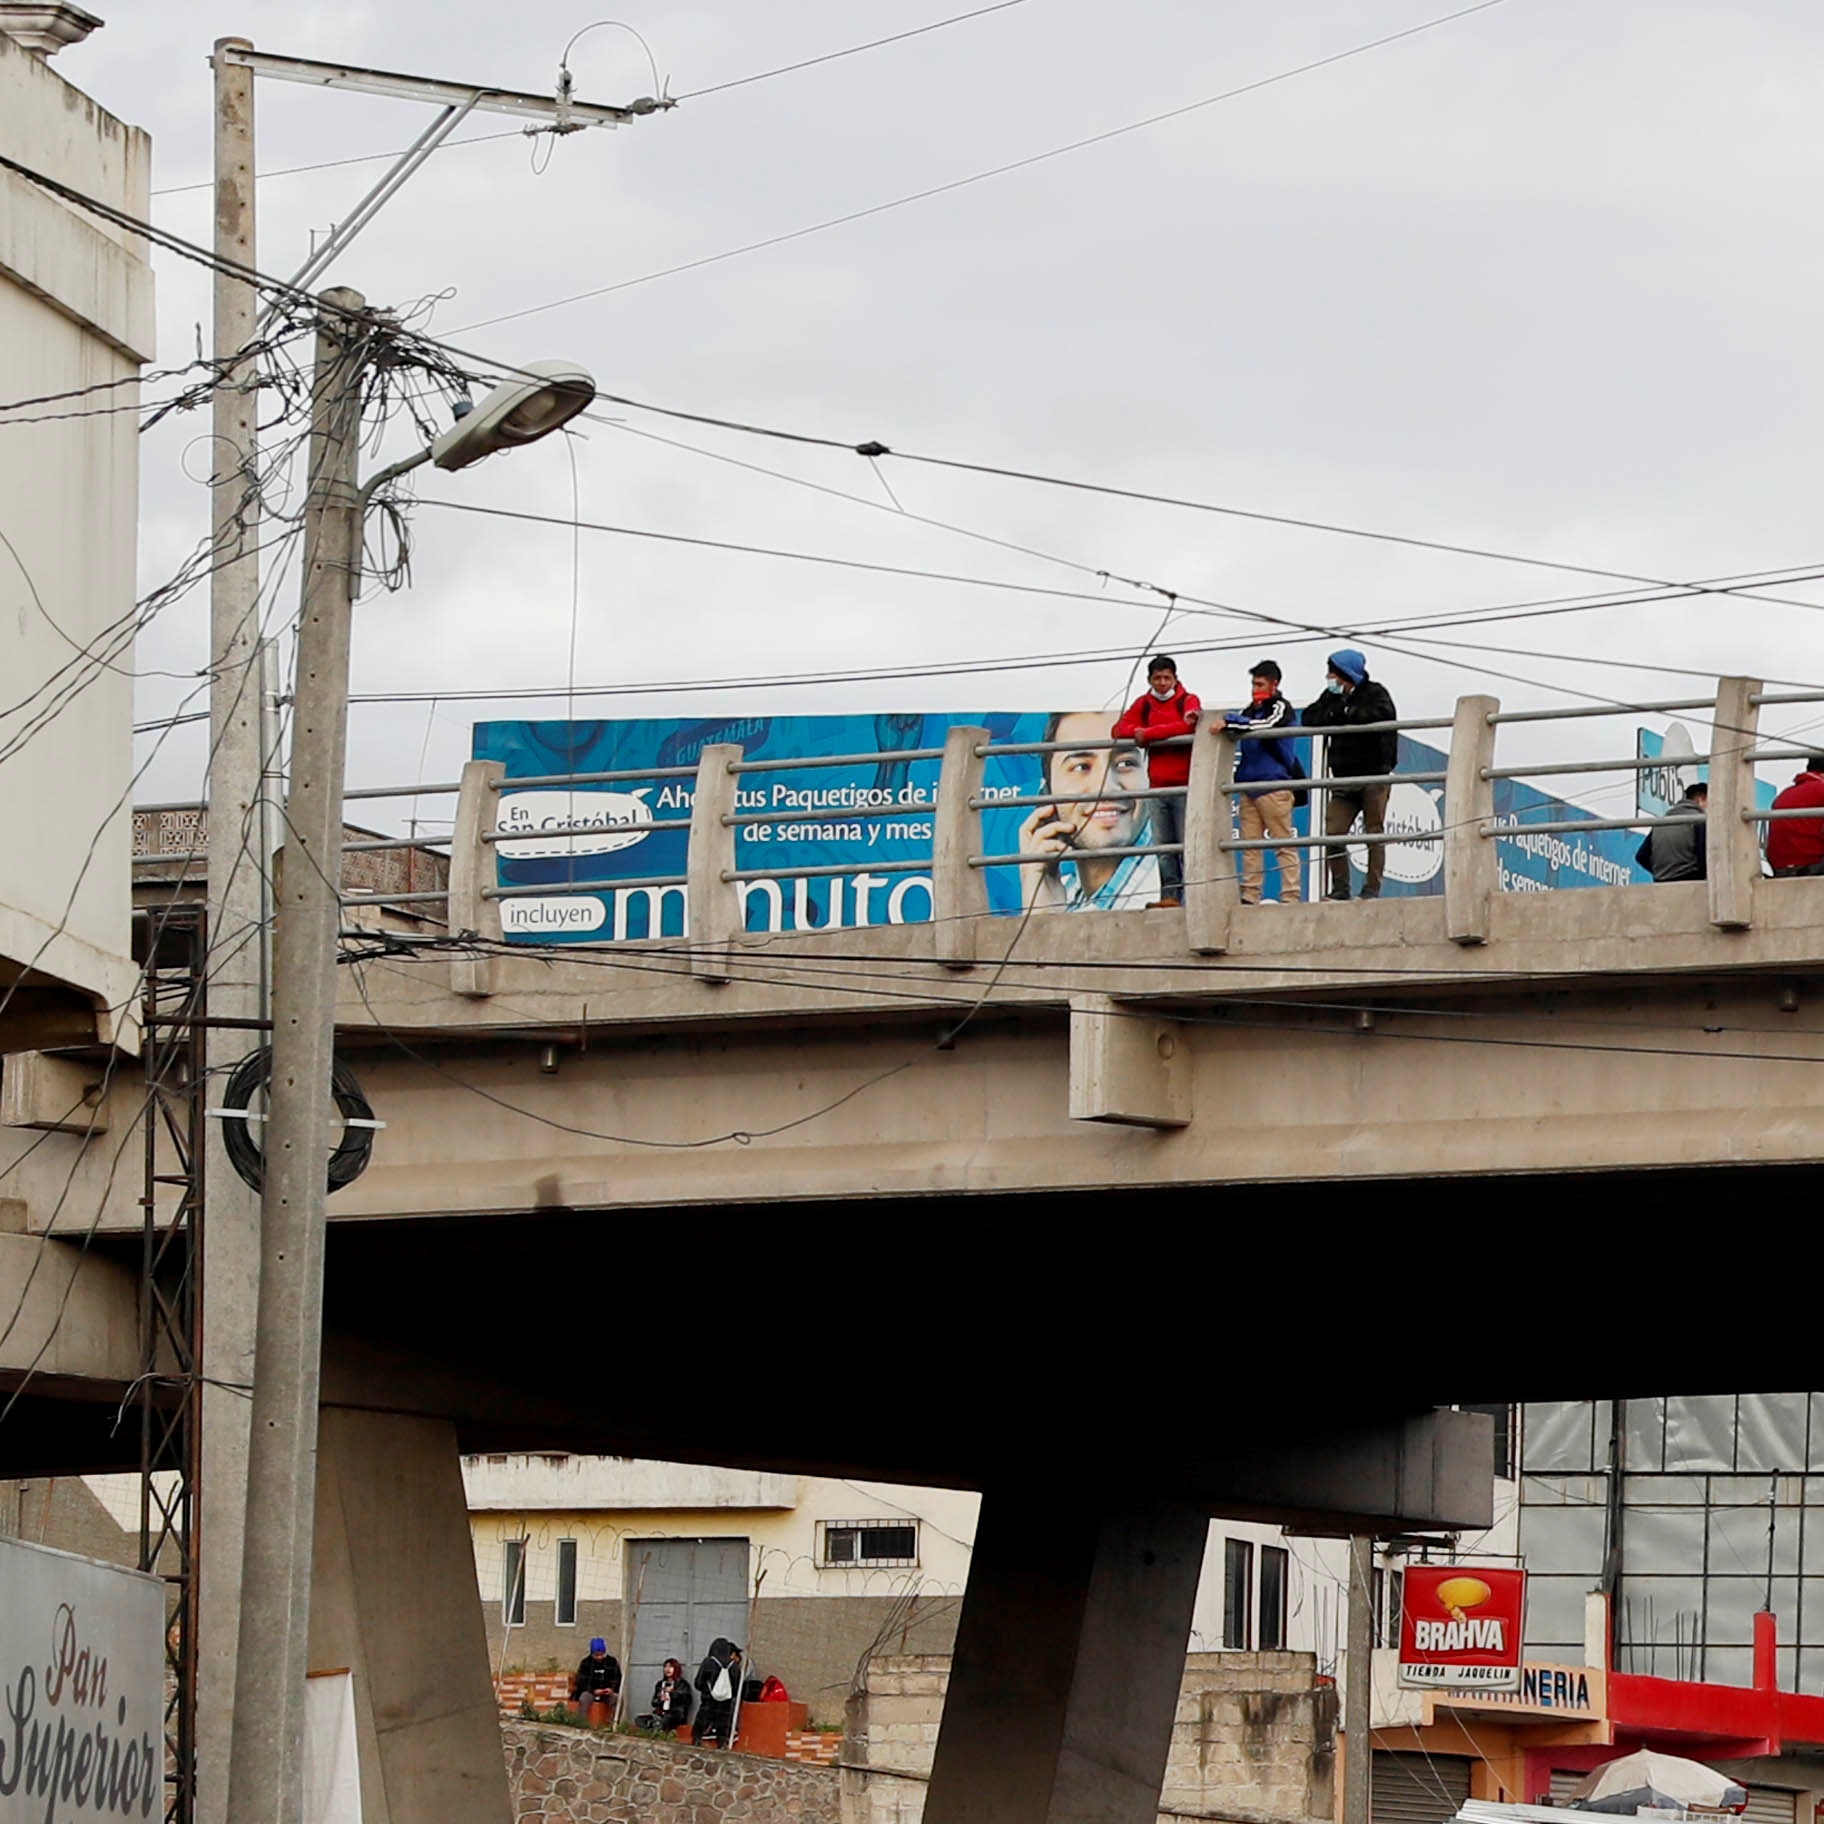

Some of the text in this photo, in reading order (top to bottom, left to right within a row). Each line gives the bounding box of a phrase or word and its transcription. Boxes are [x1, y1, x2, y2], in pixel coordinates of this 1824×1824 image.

[734, 782, 928, 812] tus Paquetigos de
[510, 807, 528, 821] En
[743, 822, 932, 846] de semana y mes
[1571, 845, 1588, 873] de
[1588, 846, 1631, 887] internet
[509, 902, 593, 929] incluyen
[614, 873, 935, 941] mnuto
[1415, 1619, 1504, 1651] BRAHVA
[46, 1603, 108, 1707] Pan
[1406, 1665, 1511, 1679] TIENDA JAQUELIN
